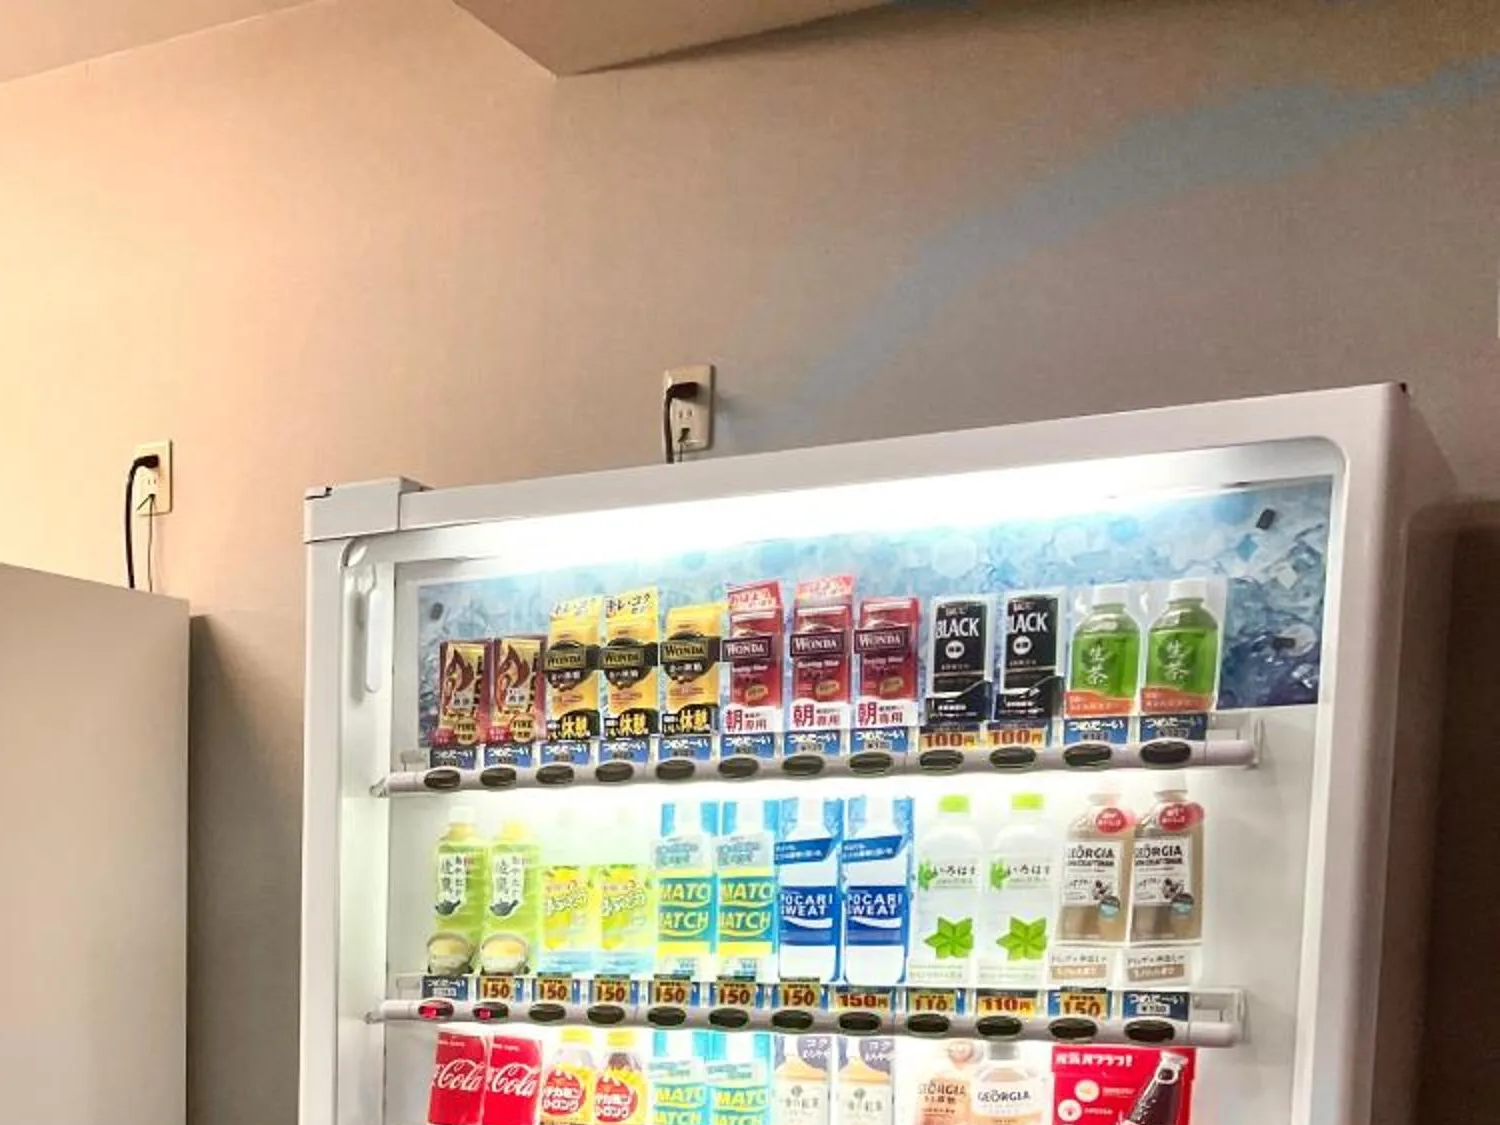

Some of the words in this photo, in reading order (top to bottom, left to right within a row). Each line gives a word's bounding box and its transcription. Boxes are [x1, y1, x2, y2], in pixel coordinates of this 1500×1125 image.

[936, 617, 980, 639] BLACK
[1008, 612, 1048, 634] LACK
[795, 637, 838, 651] WONDA
[859, 634, 901, 647] WONDA
[666, 643, 705, 656] WONDA
[727, 643, 765, 655] WONDA
[605, 652, 639, 665] WONDA
[725, 709, 743, 731] 朝
[793, 704, 815, 727] 朝
[858, 702, 878, 725] 朝
[482, 983, 510, 998] 150
[539, 984, 567, 1000] 150
[596, 986, 625, 1002] 150
[656, 987, 685, 1003] 150
[719, 989, 749, 1005] 150
[783, 989, 815, 1006] 150
[1064, 1000, 1101, 1017] 150
[438, 1058, 485, 1093] Cola
[491, 1063, 538, 1098] Cola
